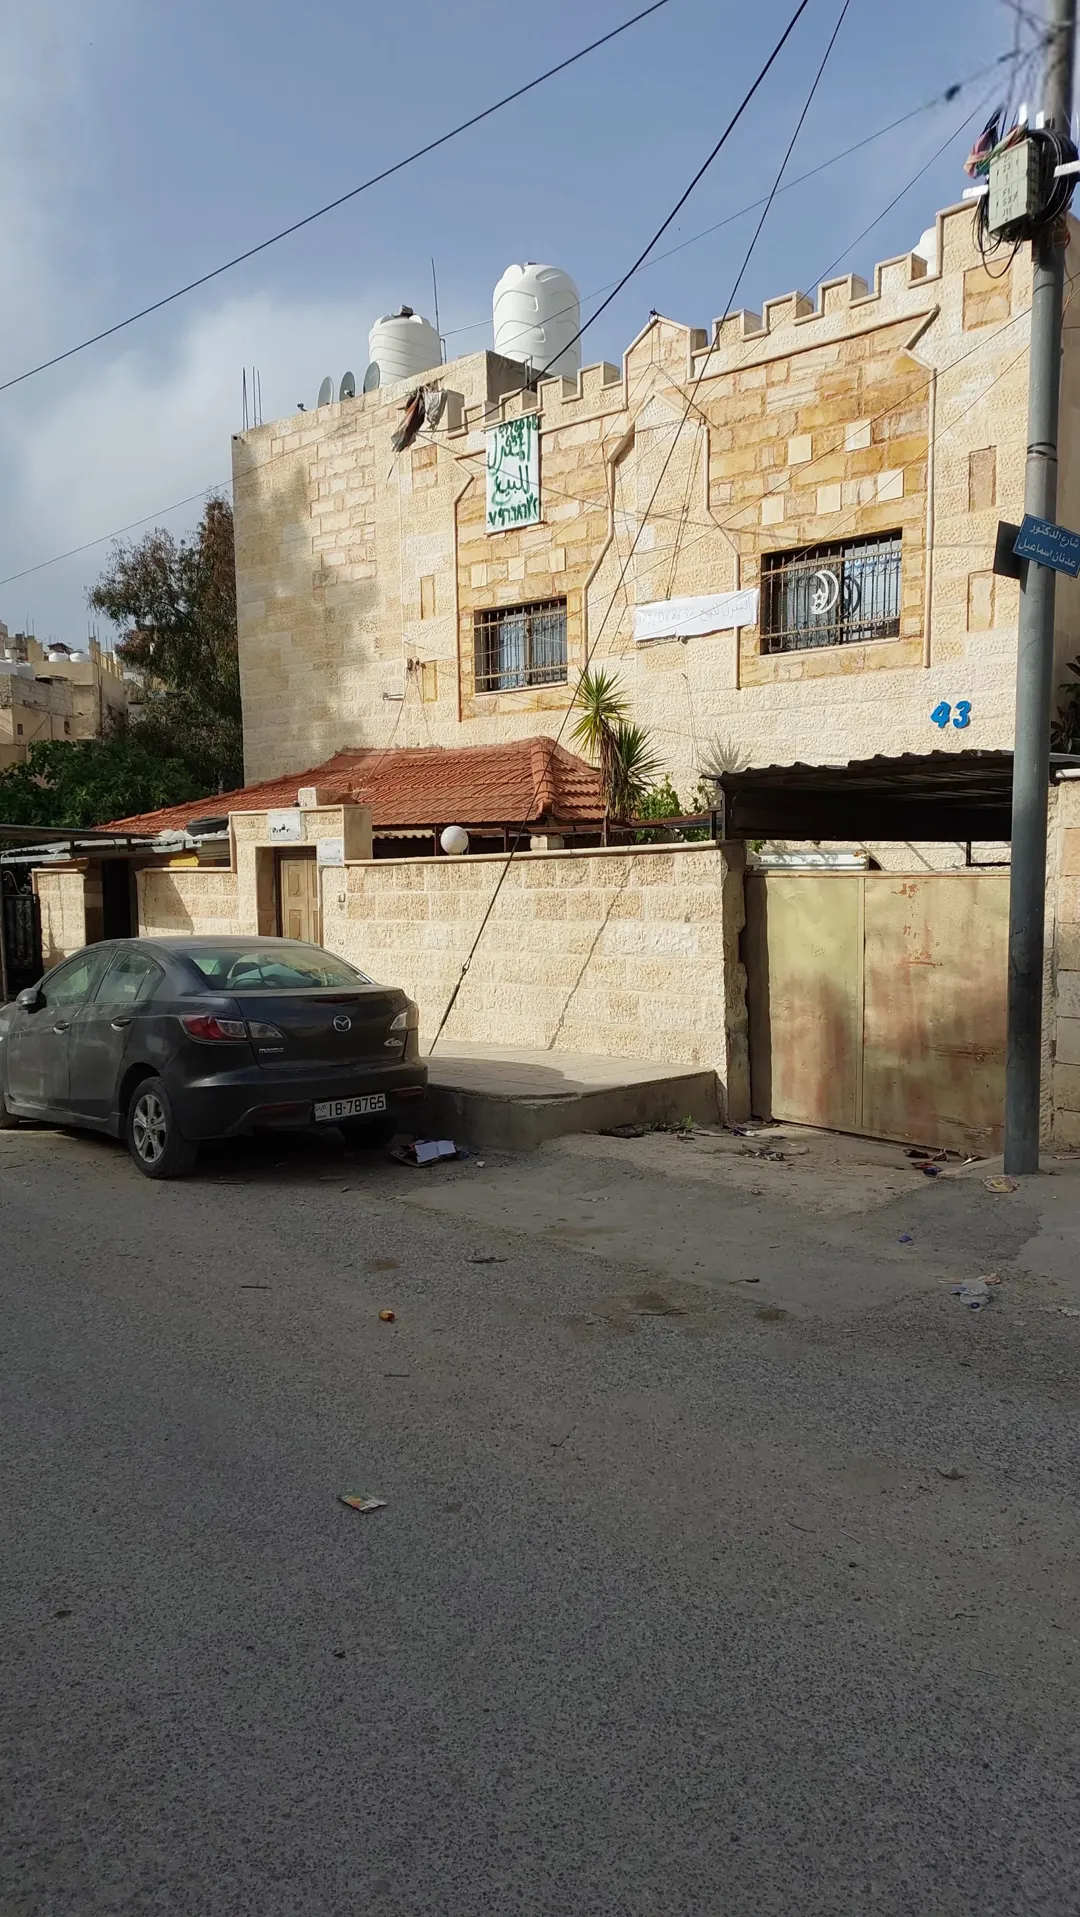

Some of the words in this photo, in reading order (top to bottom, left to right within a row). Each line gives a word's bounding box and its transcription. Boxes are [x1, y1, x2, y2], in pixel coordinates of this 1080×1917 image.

[491, 464, 530, 506] للبيع
[1029, 524, 1061, 540] الدكتور
[1018, 538, 1052, 557] اسماعيل
[1059, 535, 1080, 548] شارع
[1052, 551, 1076, 568] عدنان
[930, 700, 972, 729] 43
